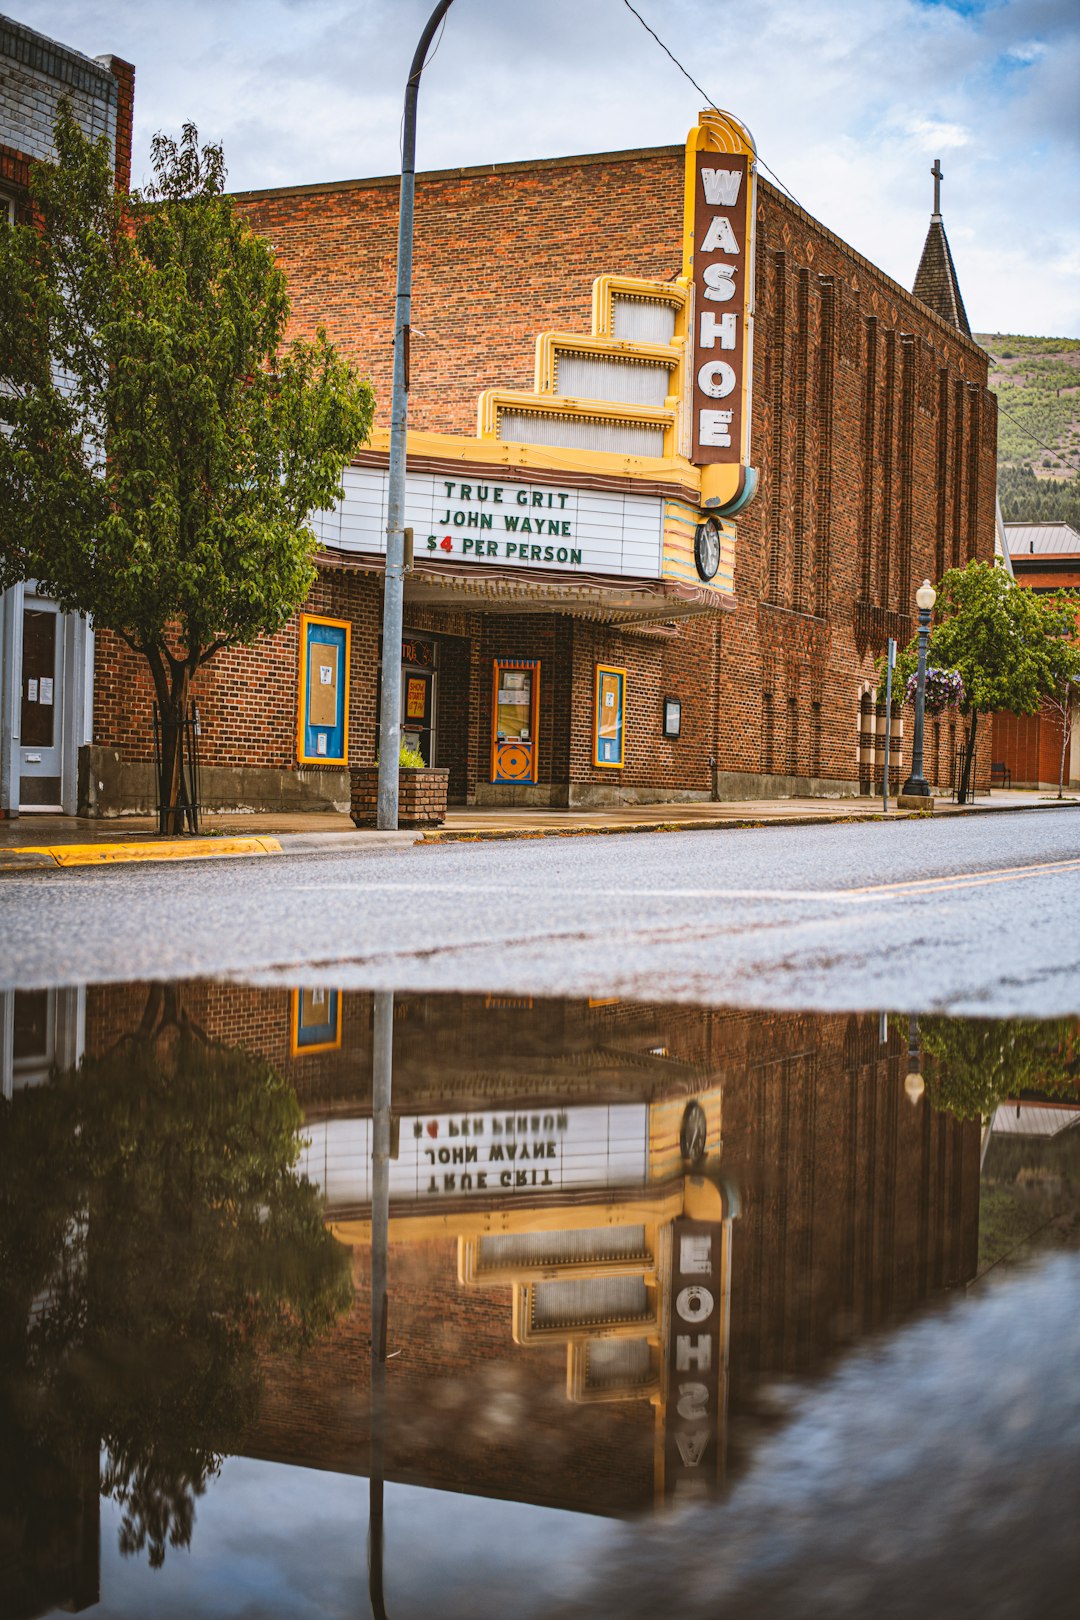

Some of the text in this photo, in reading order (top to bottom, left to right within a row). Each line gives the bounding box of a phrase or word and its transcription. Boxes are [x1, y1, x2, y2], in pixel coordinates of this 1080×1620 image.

[697, 167, 743, 448] WASHOE
[444, 481, 569, 510] TRUE GRIT
[440, 509, 571, 536] JOHN WAYNE
[427, 535, 582, 564] $4 PER PERSON
